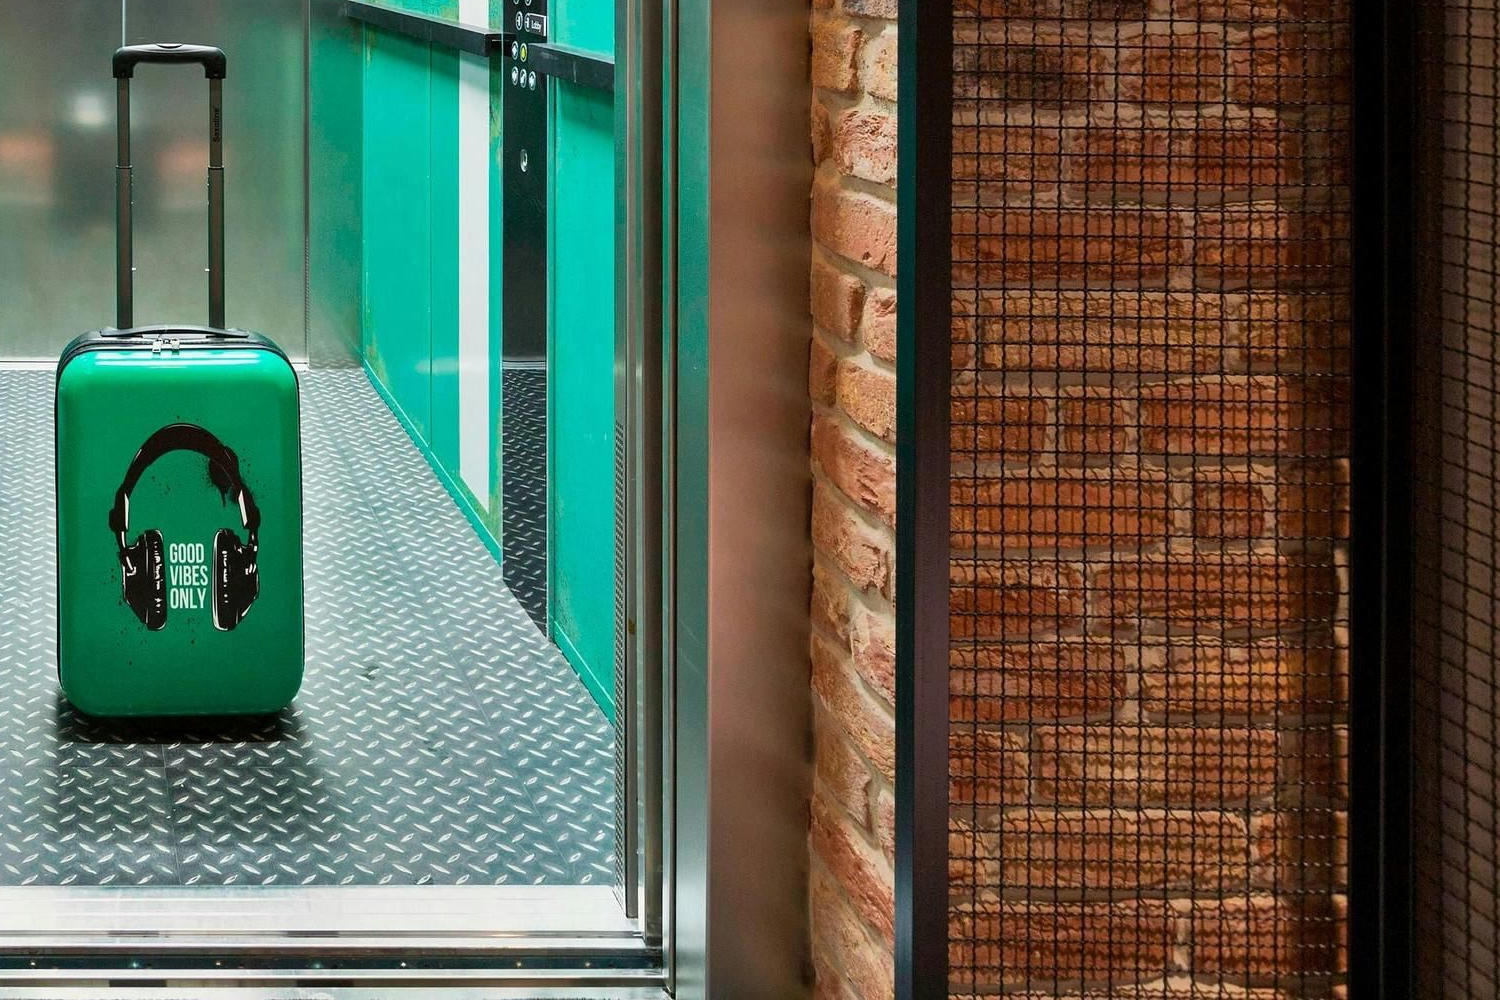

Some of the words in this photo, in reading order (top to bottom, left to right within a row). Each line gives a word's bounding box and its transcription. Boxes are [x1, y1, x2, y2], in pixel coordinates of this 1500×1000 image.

[169, 543, 205, 564] GOOD
[169, 565, 209, 586] VIBES
[169, 587, 207, 609] ONLY
